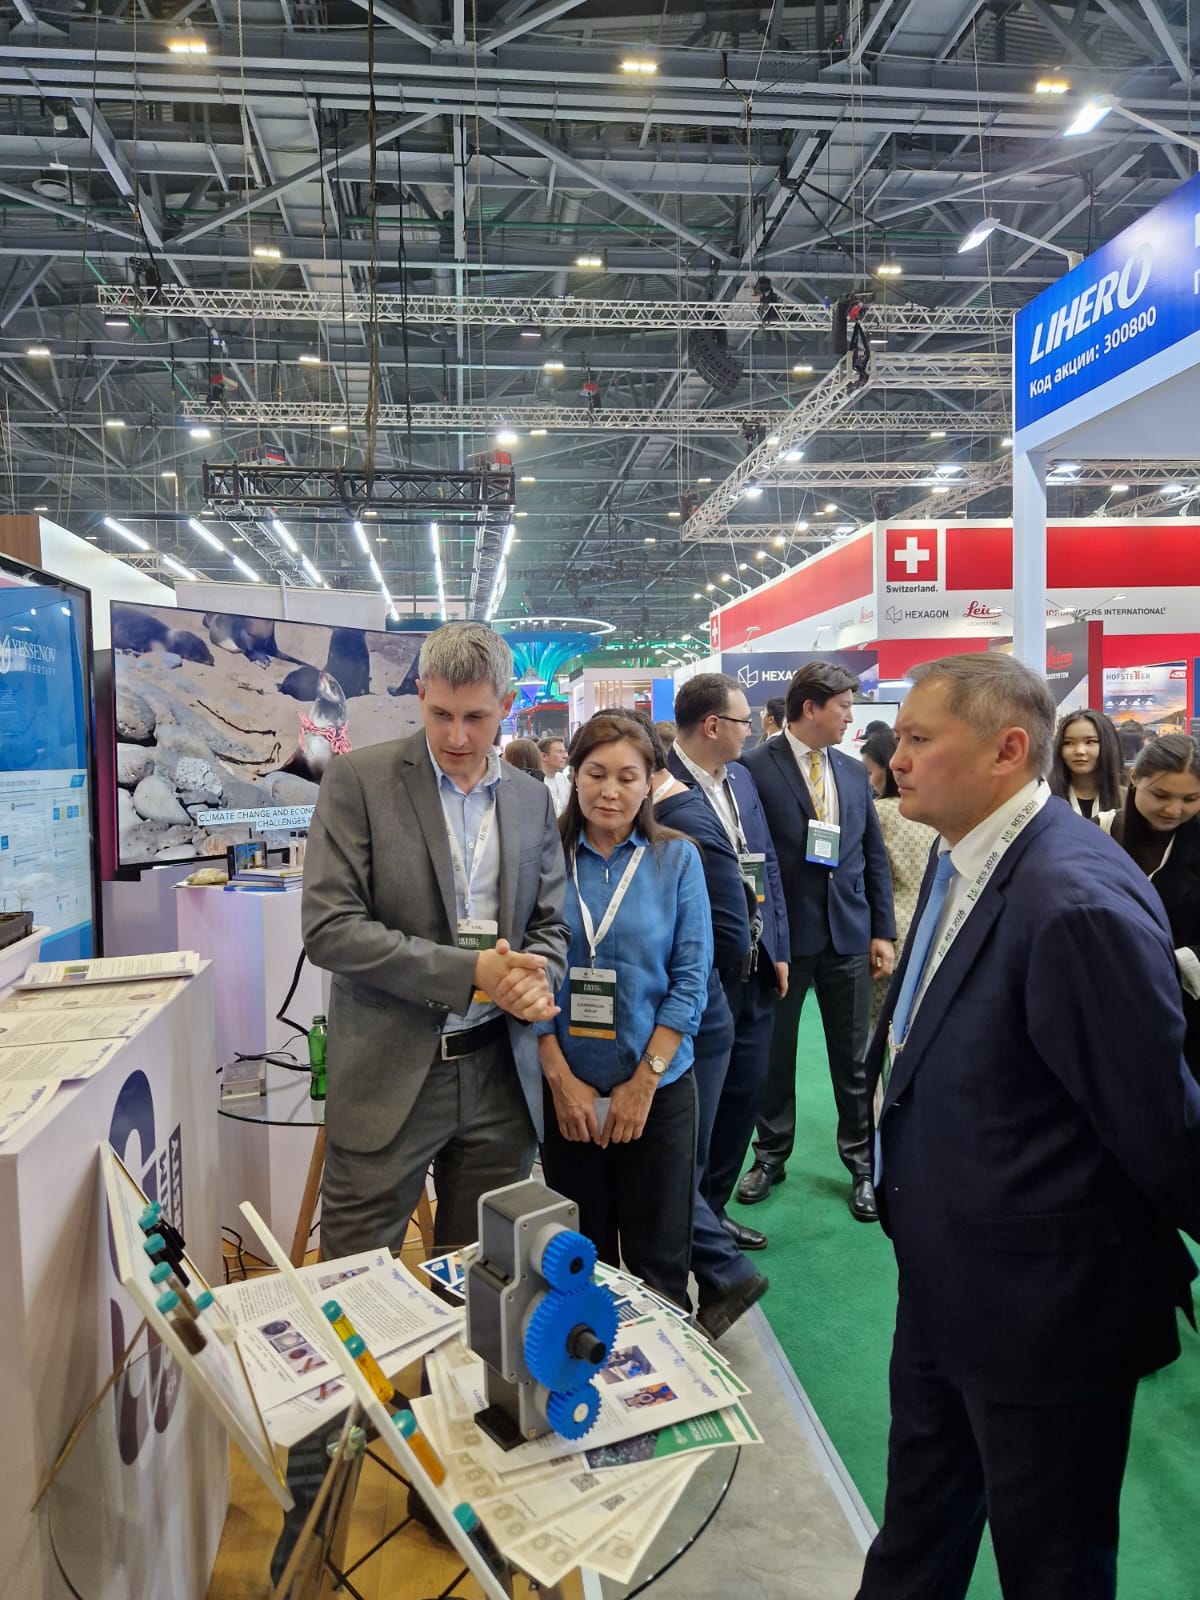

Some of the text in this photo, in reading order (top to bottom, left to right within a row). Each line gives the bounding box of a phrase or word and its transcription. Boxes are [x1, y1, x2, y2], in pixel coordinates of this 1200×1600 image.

[1030, 242, 1153, 365] LIHERO
[1030, 306, 1157, 399] Код акции: 300800
[886, 584, 939, 593] Switzerland.
[905, 609, 949, 619] HEXAGON
[962, 600, 1003, 619] Leic
[11, 638, 56, 662] YESSENOV
[14, 662, 56, 677] VERSITY
[198, 811, 235, 823] CLIMATE
[238, 809, 270, 819] CHANGE
[272, 808, 288, 816] AND
[257, 817, 307, 828] CHALLENGES
[1011, 812, 1026, 827] RES
[975, 851, 999, 886] RES 2026
[944, 909, 965, 943] RES 2026
